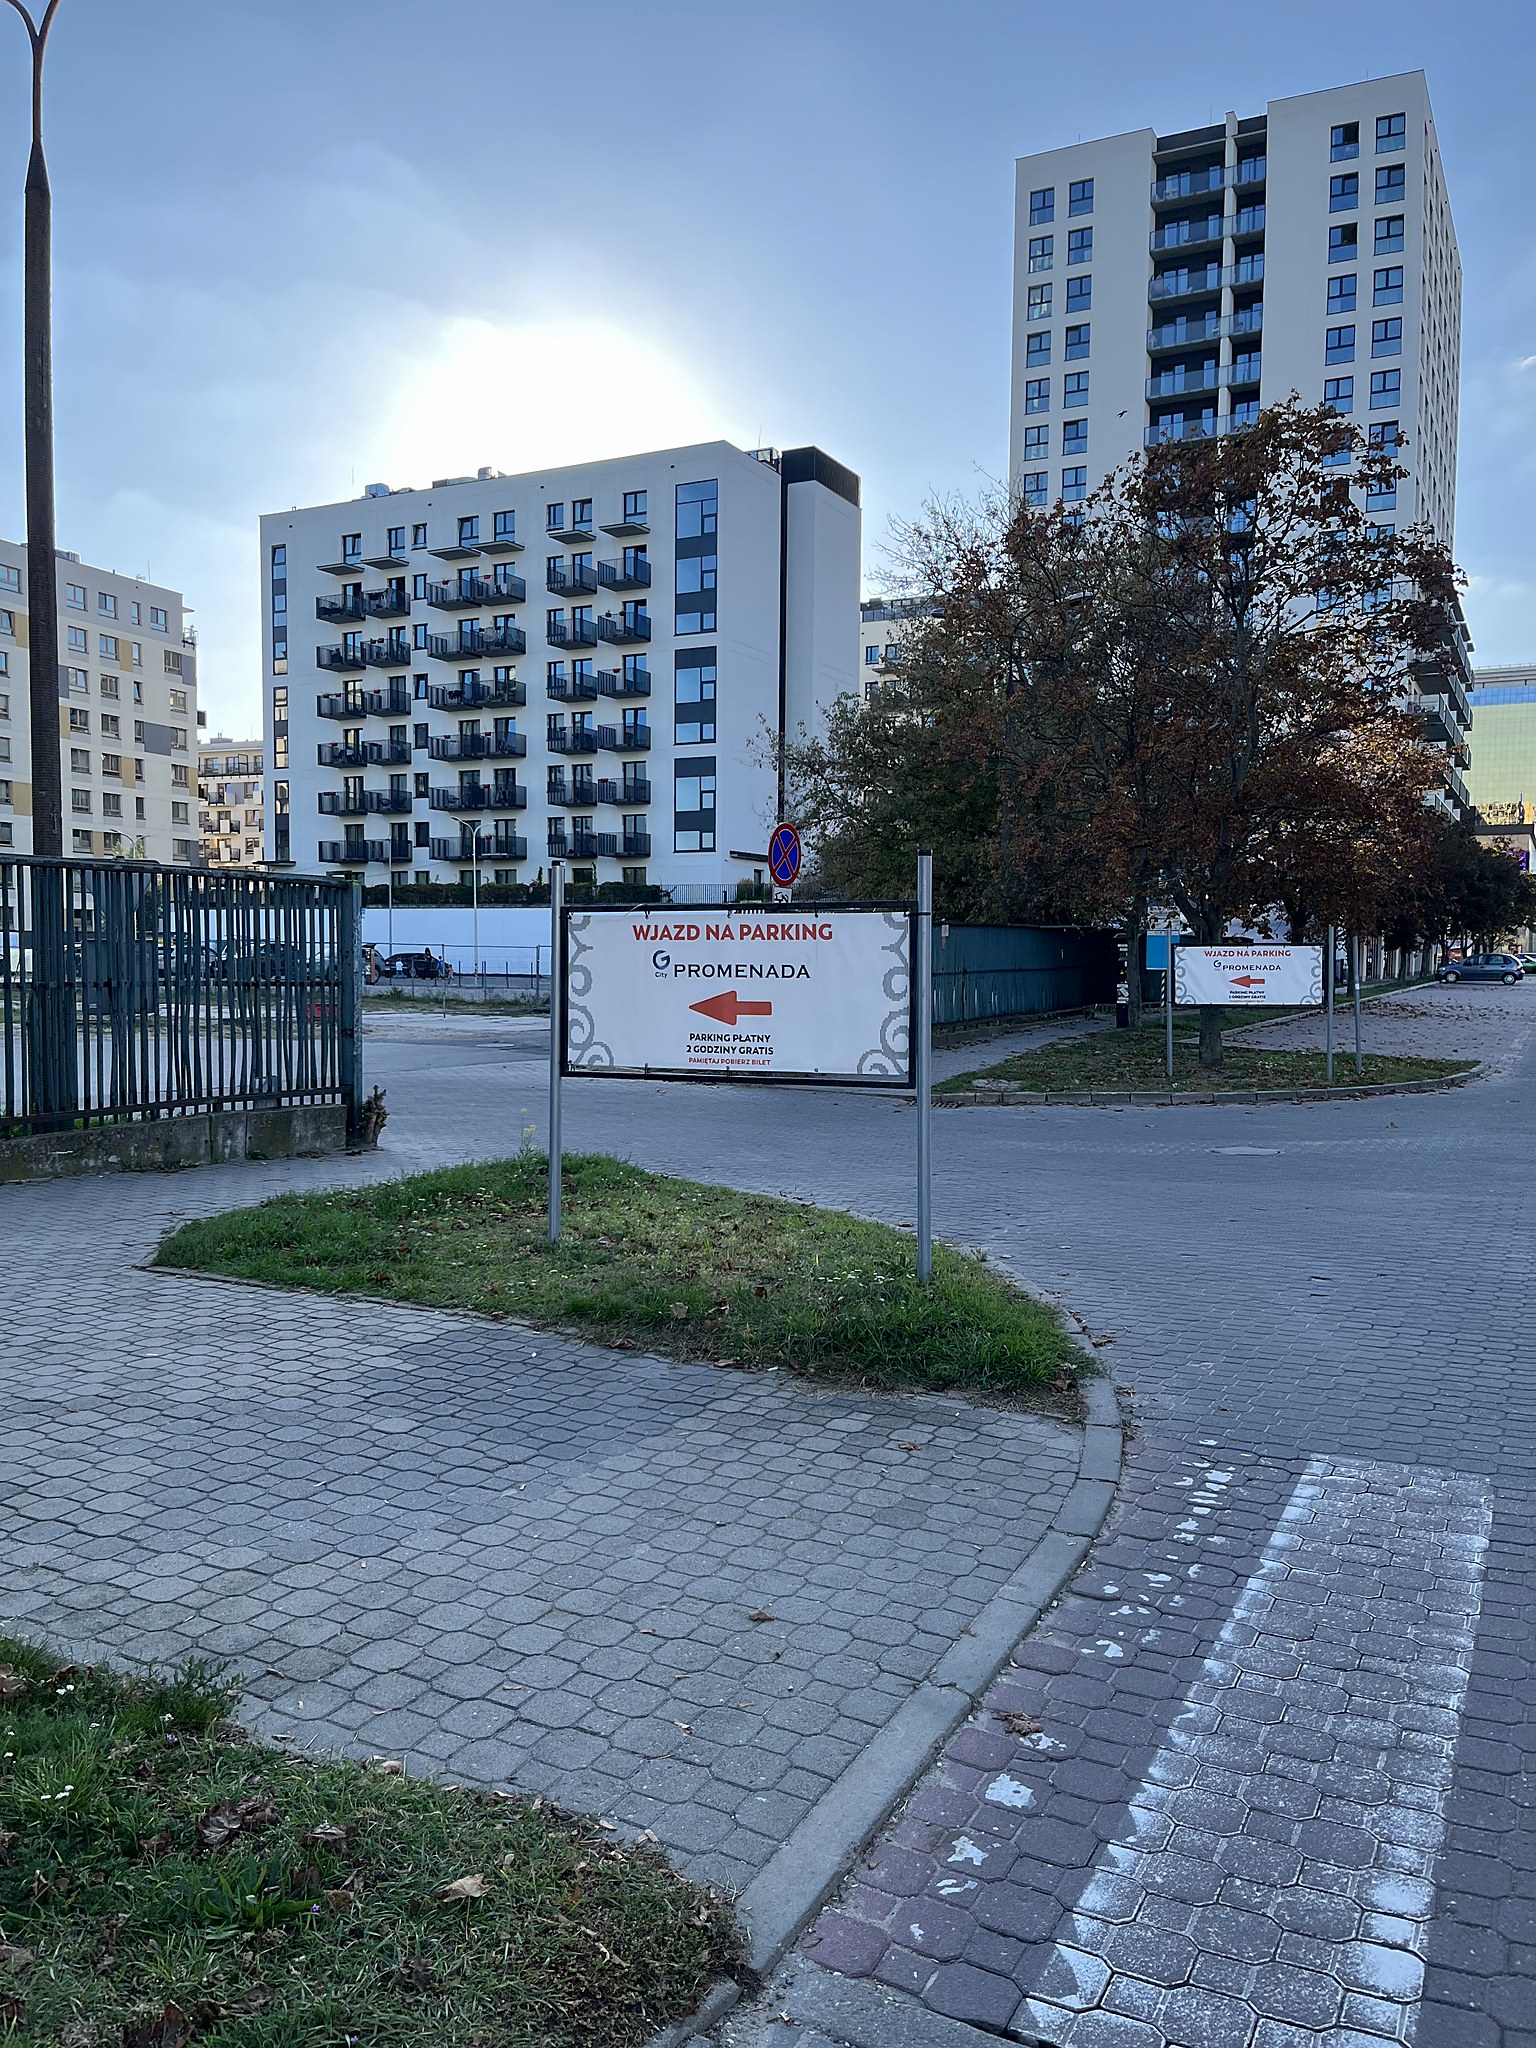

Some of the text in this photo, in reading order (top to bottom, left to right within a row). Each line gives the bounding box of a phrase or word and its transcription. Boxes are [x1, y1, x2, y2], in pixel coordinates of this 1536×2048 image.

[632, 923, 833, 941] WJAZD NA PARKING
[654, 971, 669, 980] City
[674, 964, 811, 979] PROMENADA
[689, 1033, 771, 1043] PARKING PŁATNY
[686, 1045, 774, 1055] 2 GODZINY GRATIS
[688, 1057, 720, 1065] PAMIĘTAJ
